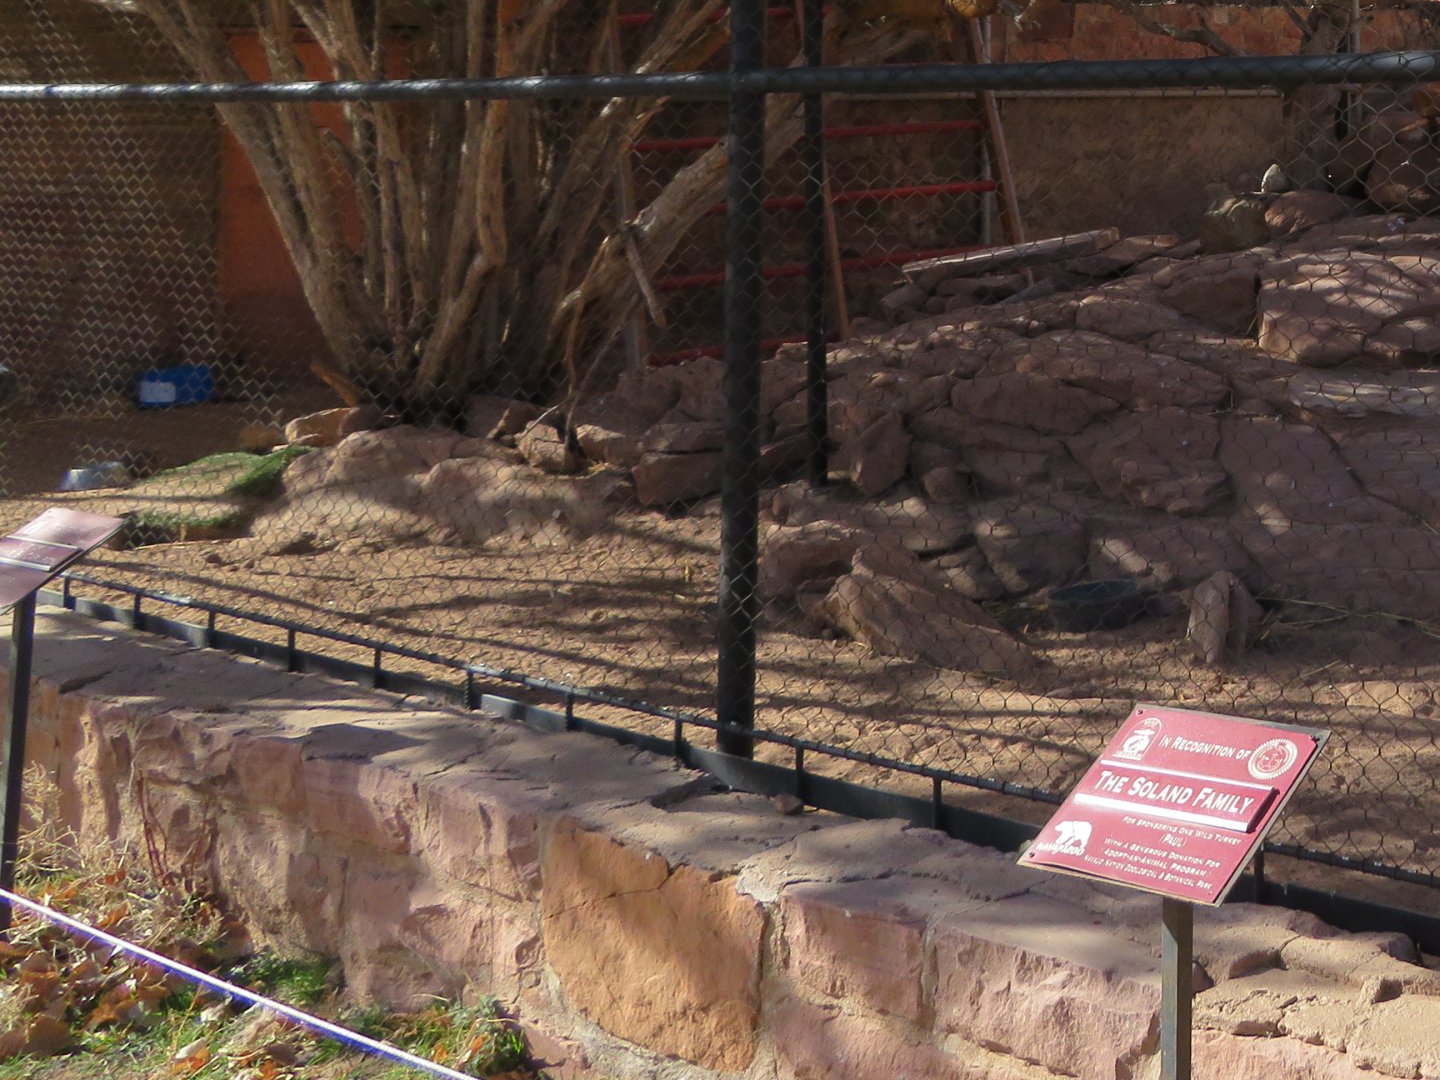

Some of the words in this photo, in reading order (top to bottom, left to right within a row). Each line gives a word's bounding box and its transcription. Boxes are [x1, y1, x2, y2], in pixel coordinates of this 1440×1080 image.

[1159, 735, 1172, 748] IN
[1172, 737, 1236, 758] RECOGNITION
[1236, 749, 1252, 760] OF
[1095, 771, 1129, 794] THE
[1128, 777, 1193, 804] SOLAND
[1192, 787, 1255, 814] FAMILY
